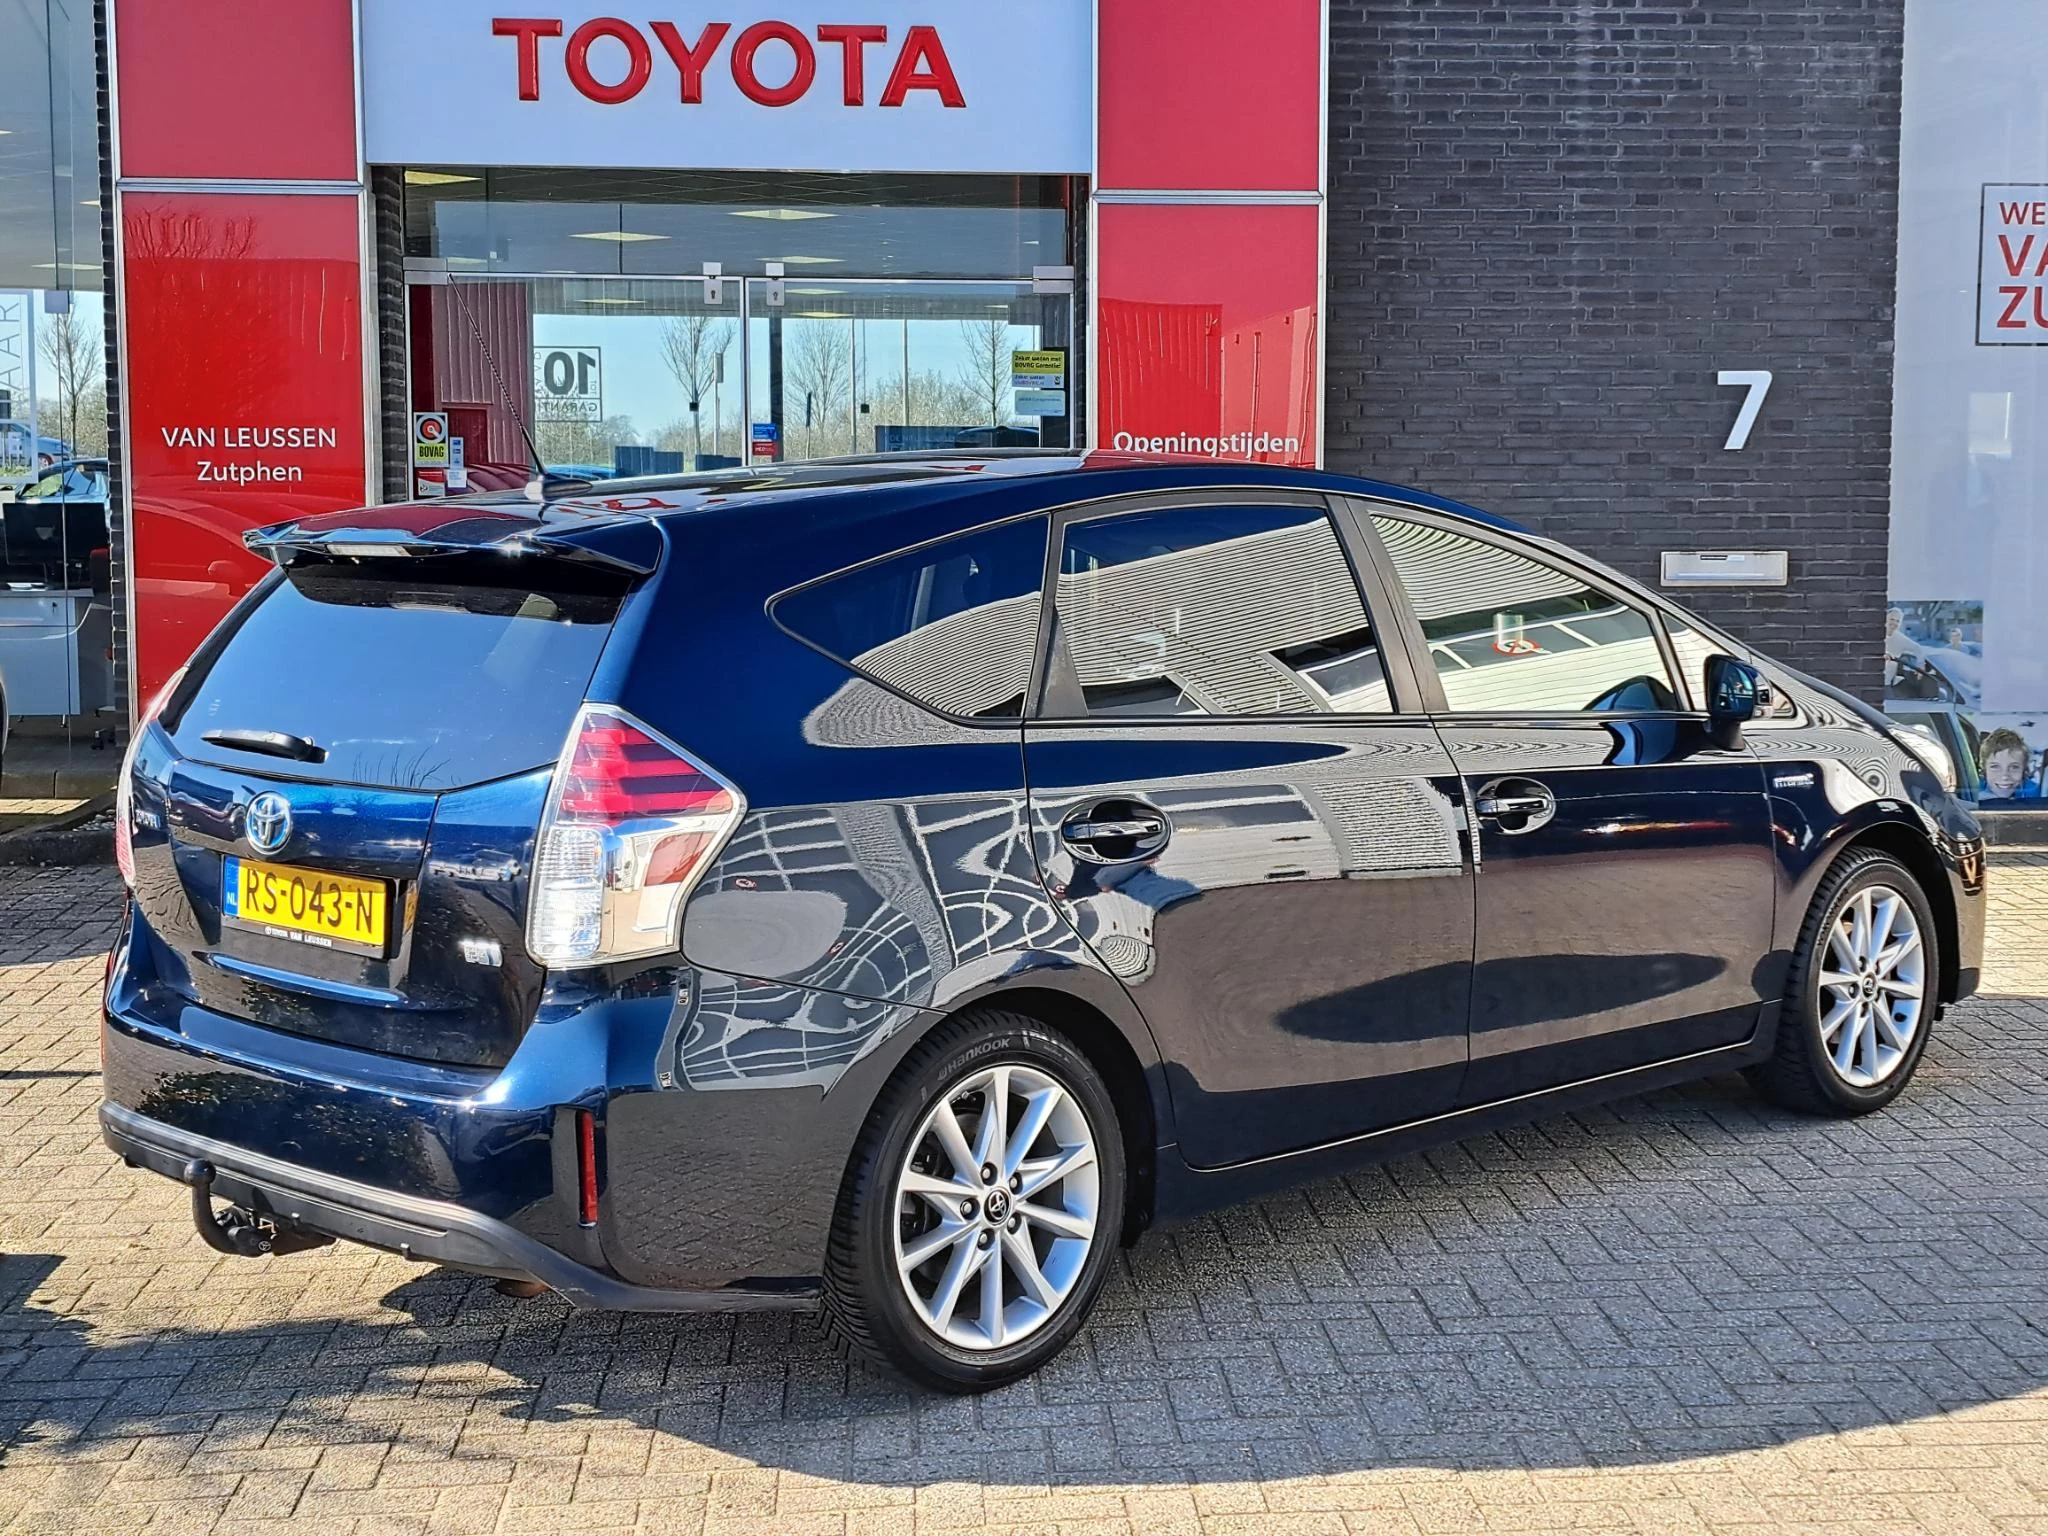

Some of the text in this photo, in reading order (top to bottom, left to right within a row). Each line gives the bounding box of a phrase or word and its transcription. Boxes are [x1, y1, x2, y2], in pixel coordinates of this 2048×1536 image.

[492, 16, 967, 108] TOYOTA
[1717, 370, 1773, 449] 7
[161, 427, 336, 448] VAN LEUSSEN
[1113, 431, 1299, 458] Openingstijden
[419, 446, 444, 457] BOVAG
[197, 460, 302, 486] Zutphen
[227, 892, 237, 906] NL
[246, 868, 373, 934] RS-043-N
